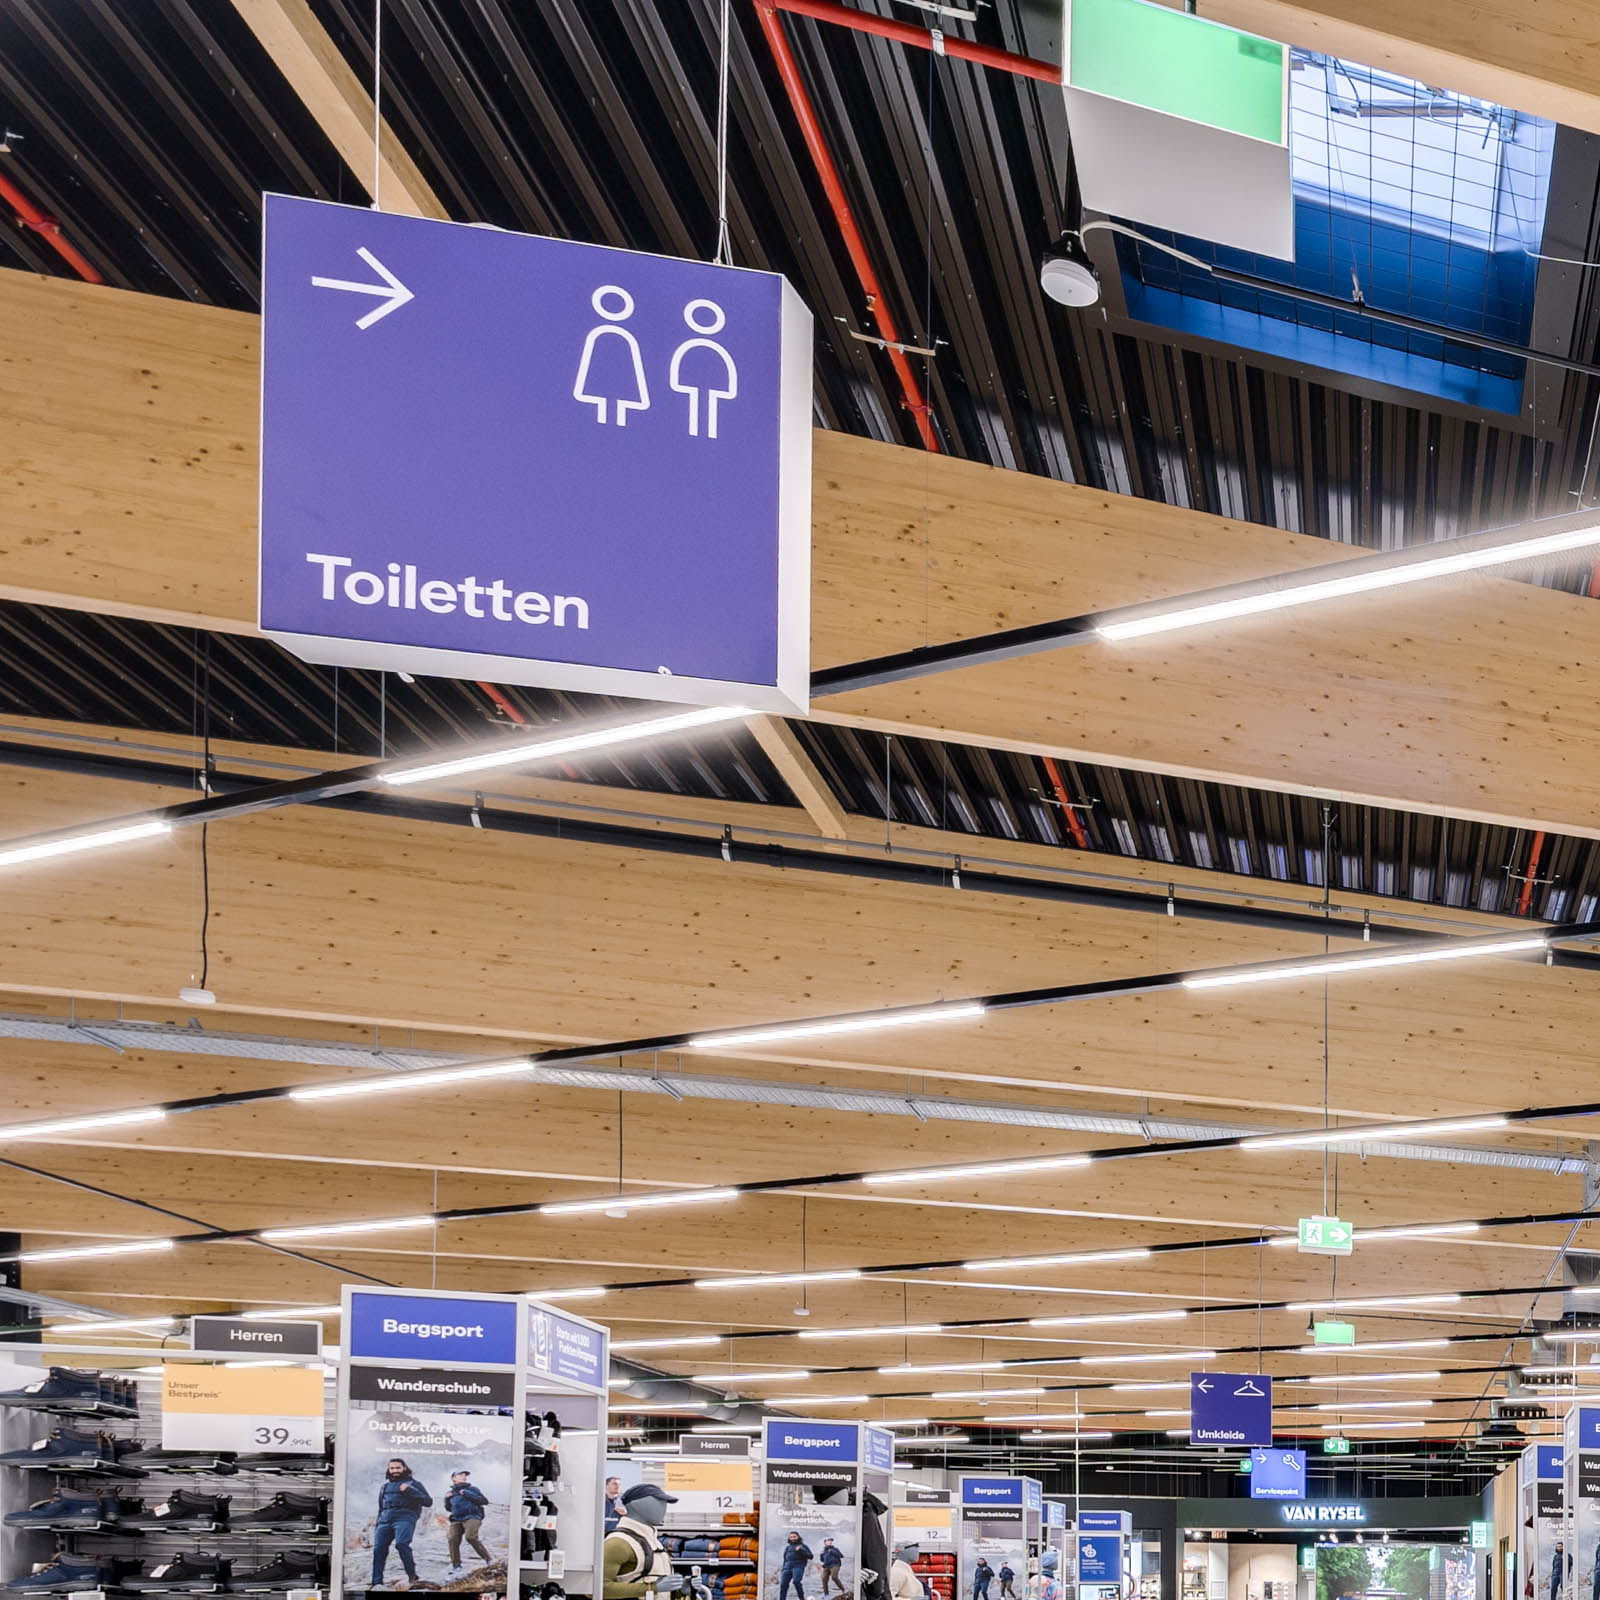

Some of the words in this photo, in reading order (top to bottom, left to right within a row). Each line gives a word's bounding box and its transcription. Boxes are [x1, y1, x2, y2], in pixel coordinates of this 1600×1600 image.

[306, 552, 589, 630] Toiletten
[382, 1318, 484, 1339] Bergsport
[230, 1329, 283, 1343] Herren
[168, 1381, 200, 1389] Unser
[377, 1377, 492, 1395] Wanderschuhe
[368, 1419, 393, 1432] Das
[396, 1421, 443, 1434] Wetter
[390, 1434, 456, 1447] sportlich.
[1197, 1430, 1245, 1440] Umkleide
[700, 1441, 730, 1449] Herren
[784, 1436, 840, 1448] Bergsport
[773, 1470, 852, 1482] Wanderbekleidung
[974, 1487, 1012, 1496] Bergsport
[1255, 1487, 1298, 1496] Servicepoint
[1284, 1506, 1315, 1520] VAN
[1319, 1507, 1365, 1520] RYSEL
